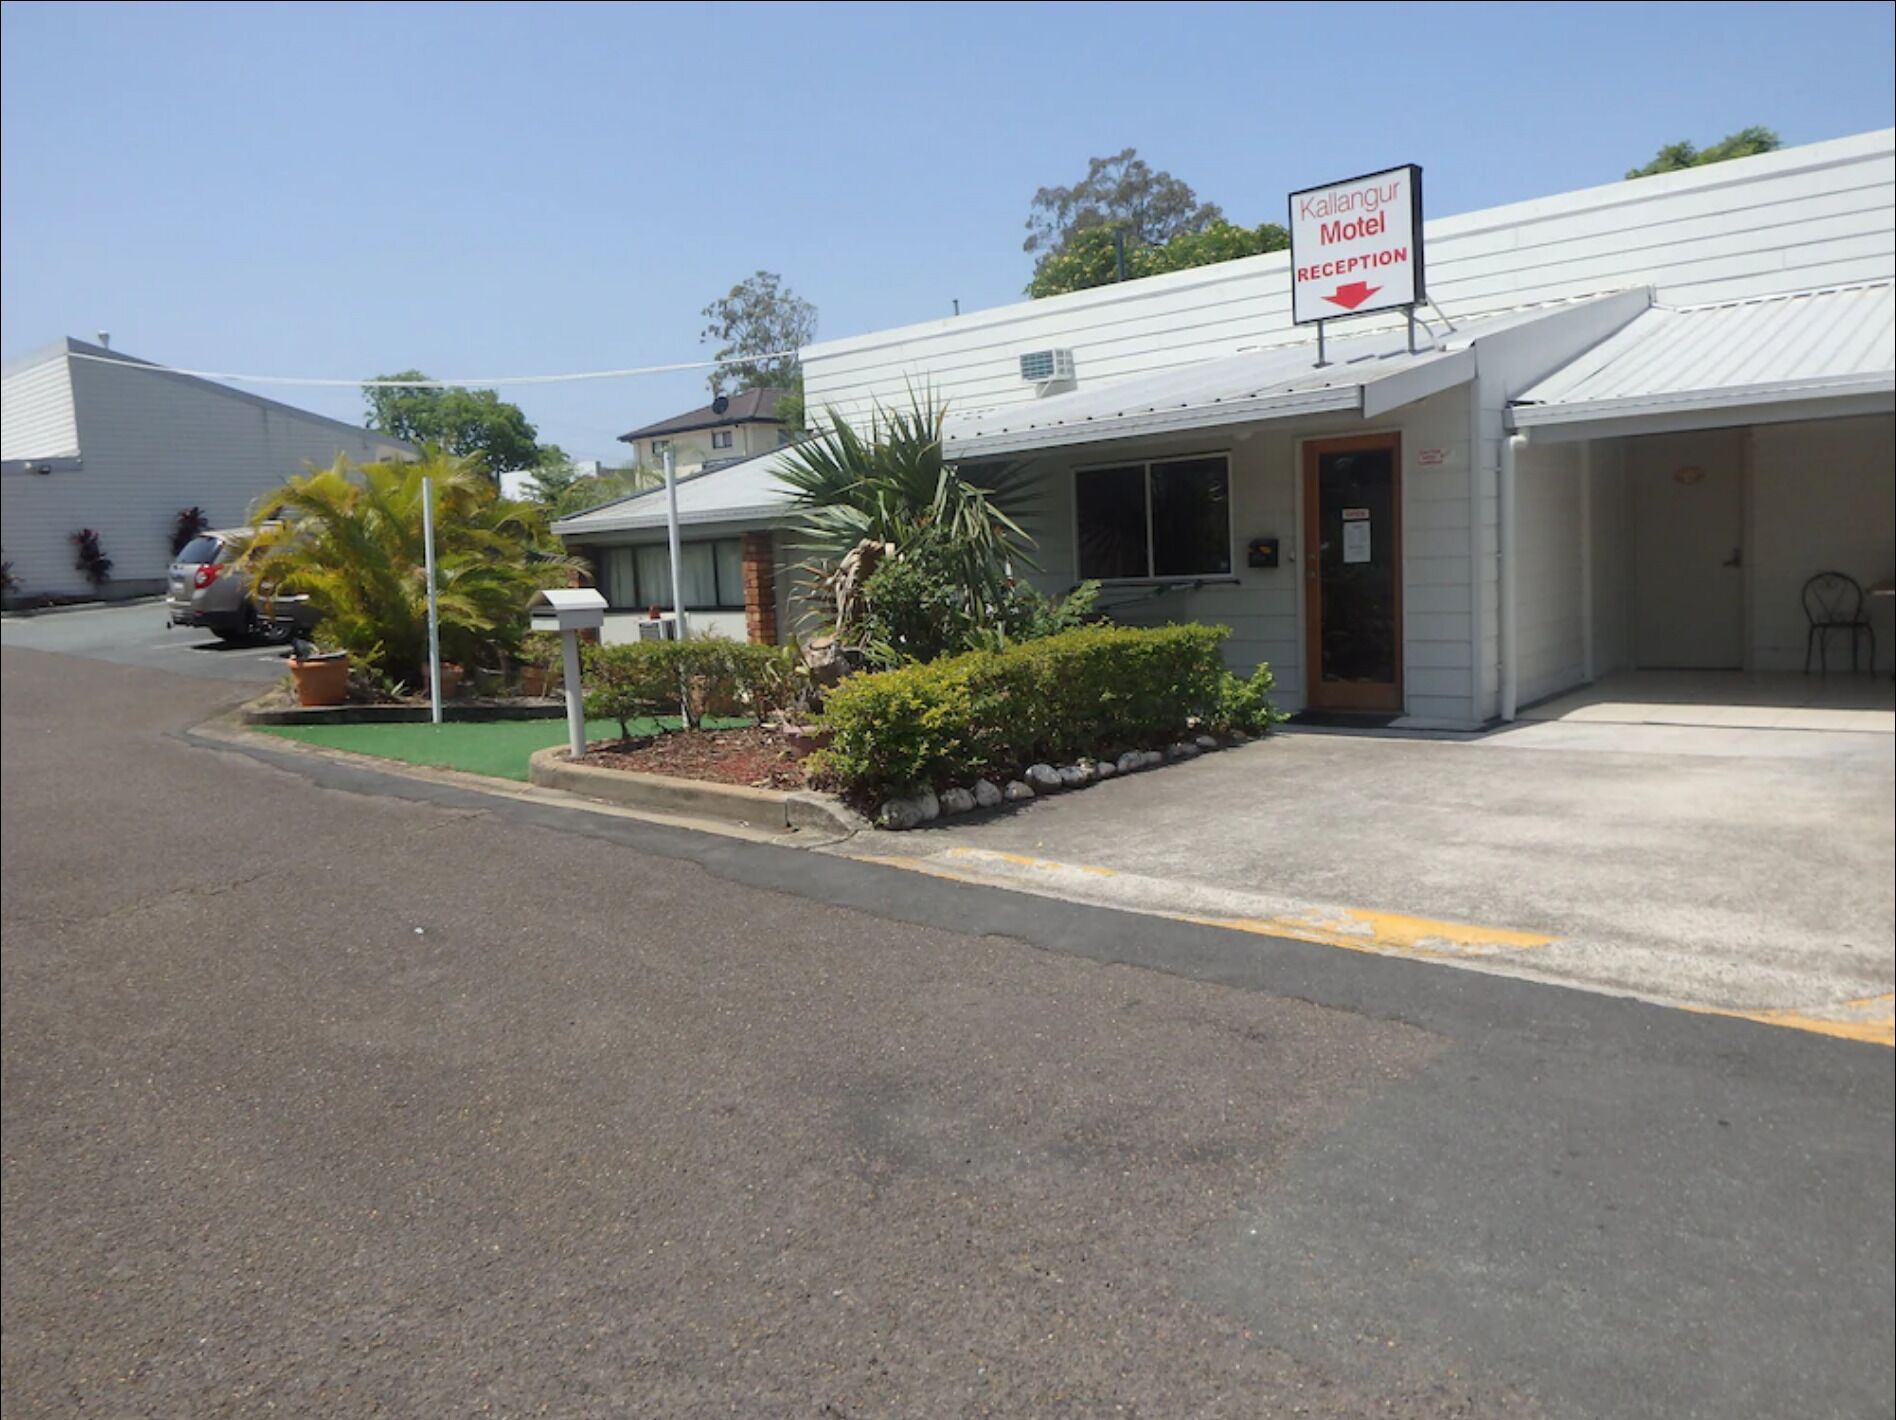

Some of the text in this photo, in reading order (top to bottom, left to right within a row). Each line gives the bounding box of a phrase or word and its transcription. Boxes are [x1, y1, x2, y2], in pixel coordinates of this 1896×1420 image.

[1300, 182, 1400, 221] Kallangur
[1320, 211, 1385, 246] Motel
[1298, 247, 1407, 282] RECEPTION
